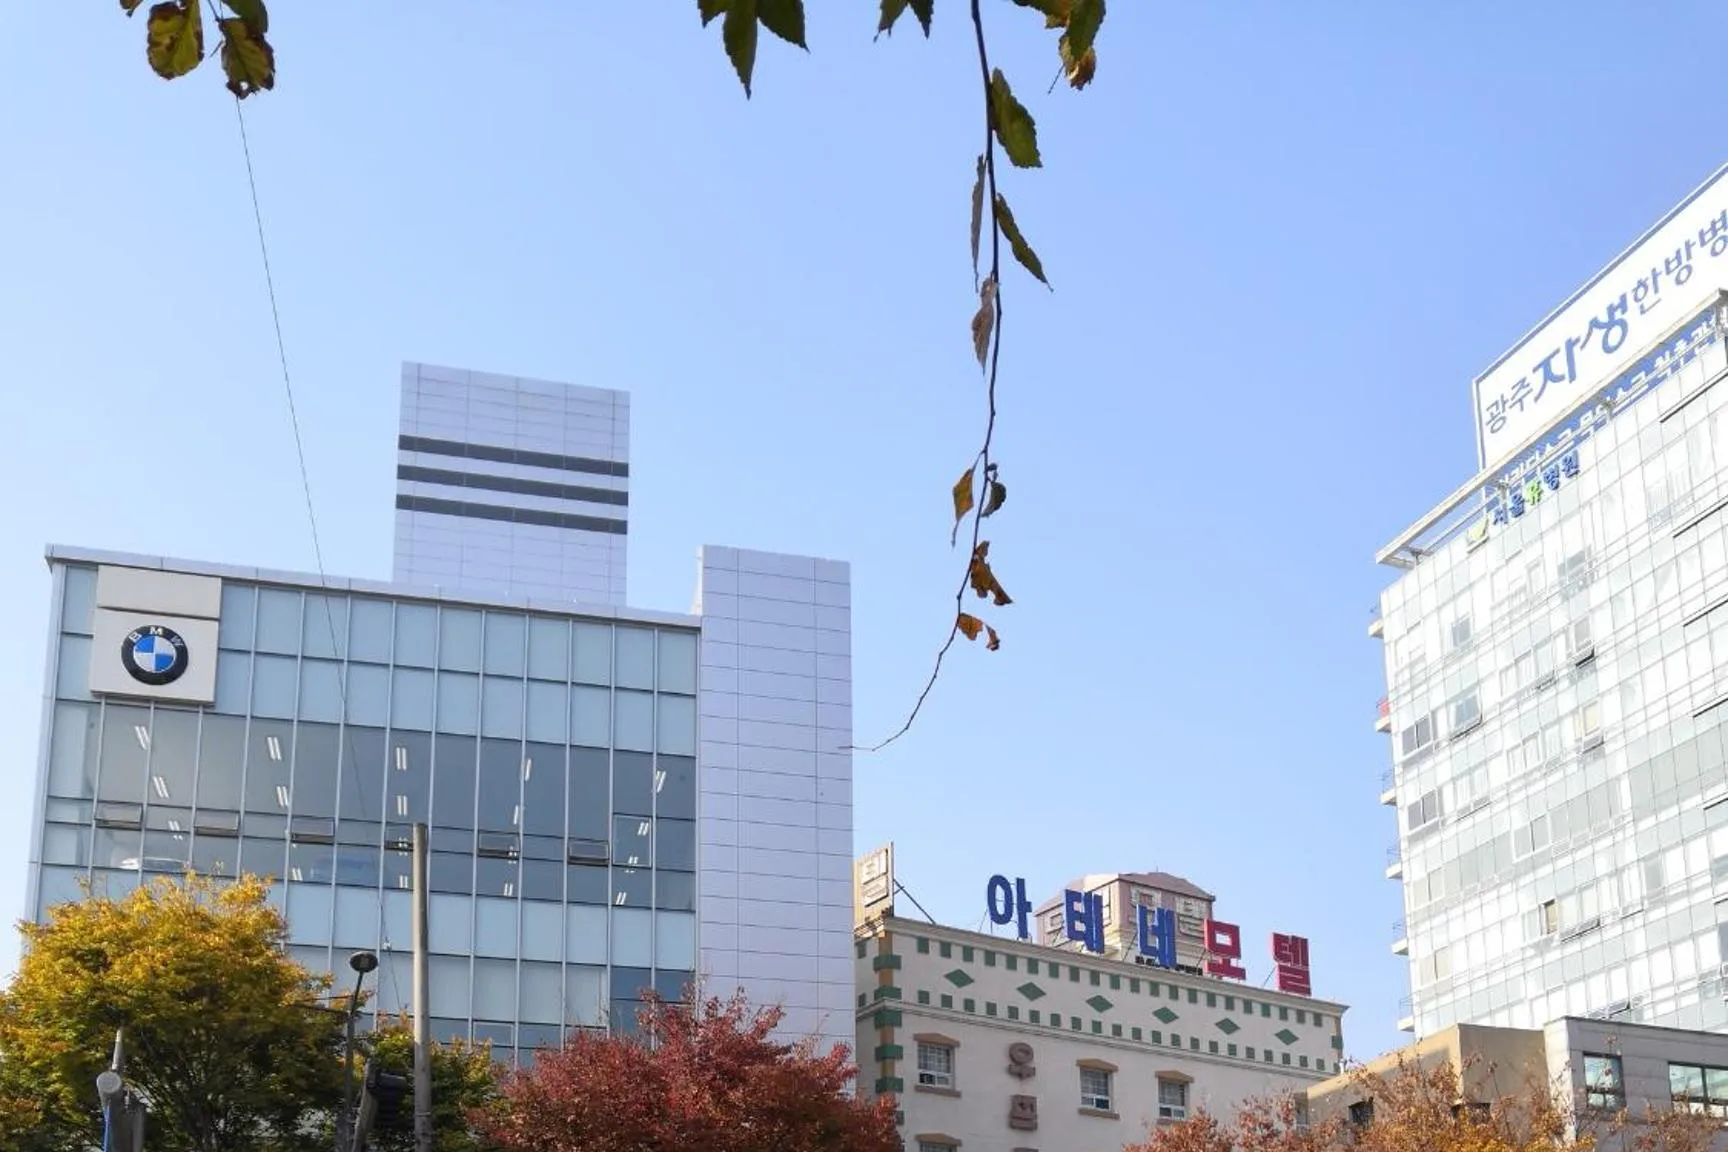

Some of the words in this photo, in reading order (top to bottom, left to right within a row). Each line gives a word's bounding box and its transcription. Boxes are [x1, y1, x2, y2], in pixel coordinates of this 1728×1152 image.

[128, 626, 185, 647] BMW
[987, 874, 1176, 969] 아테네
[1204, 918, 1311, 996] 모텔
